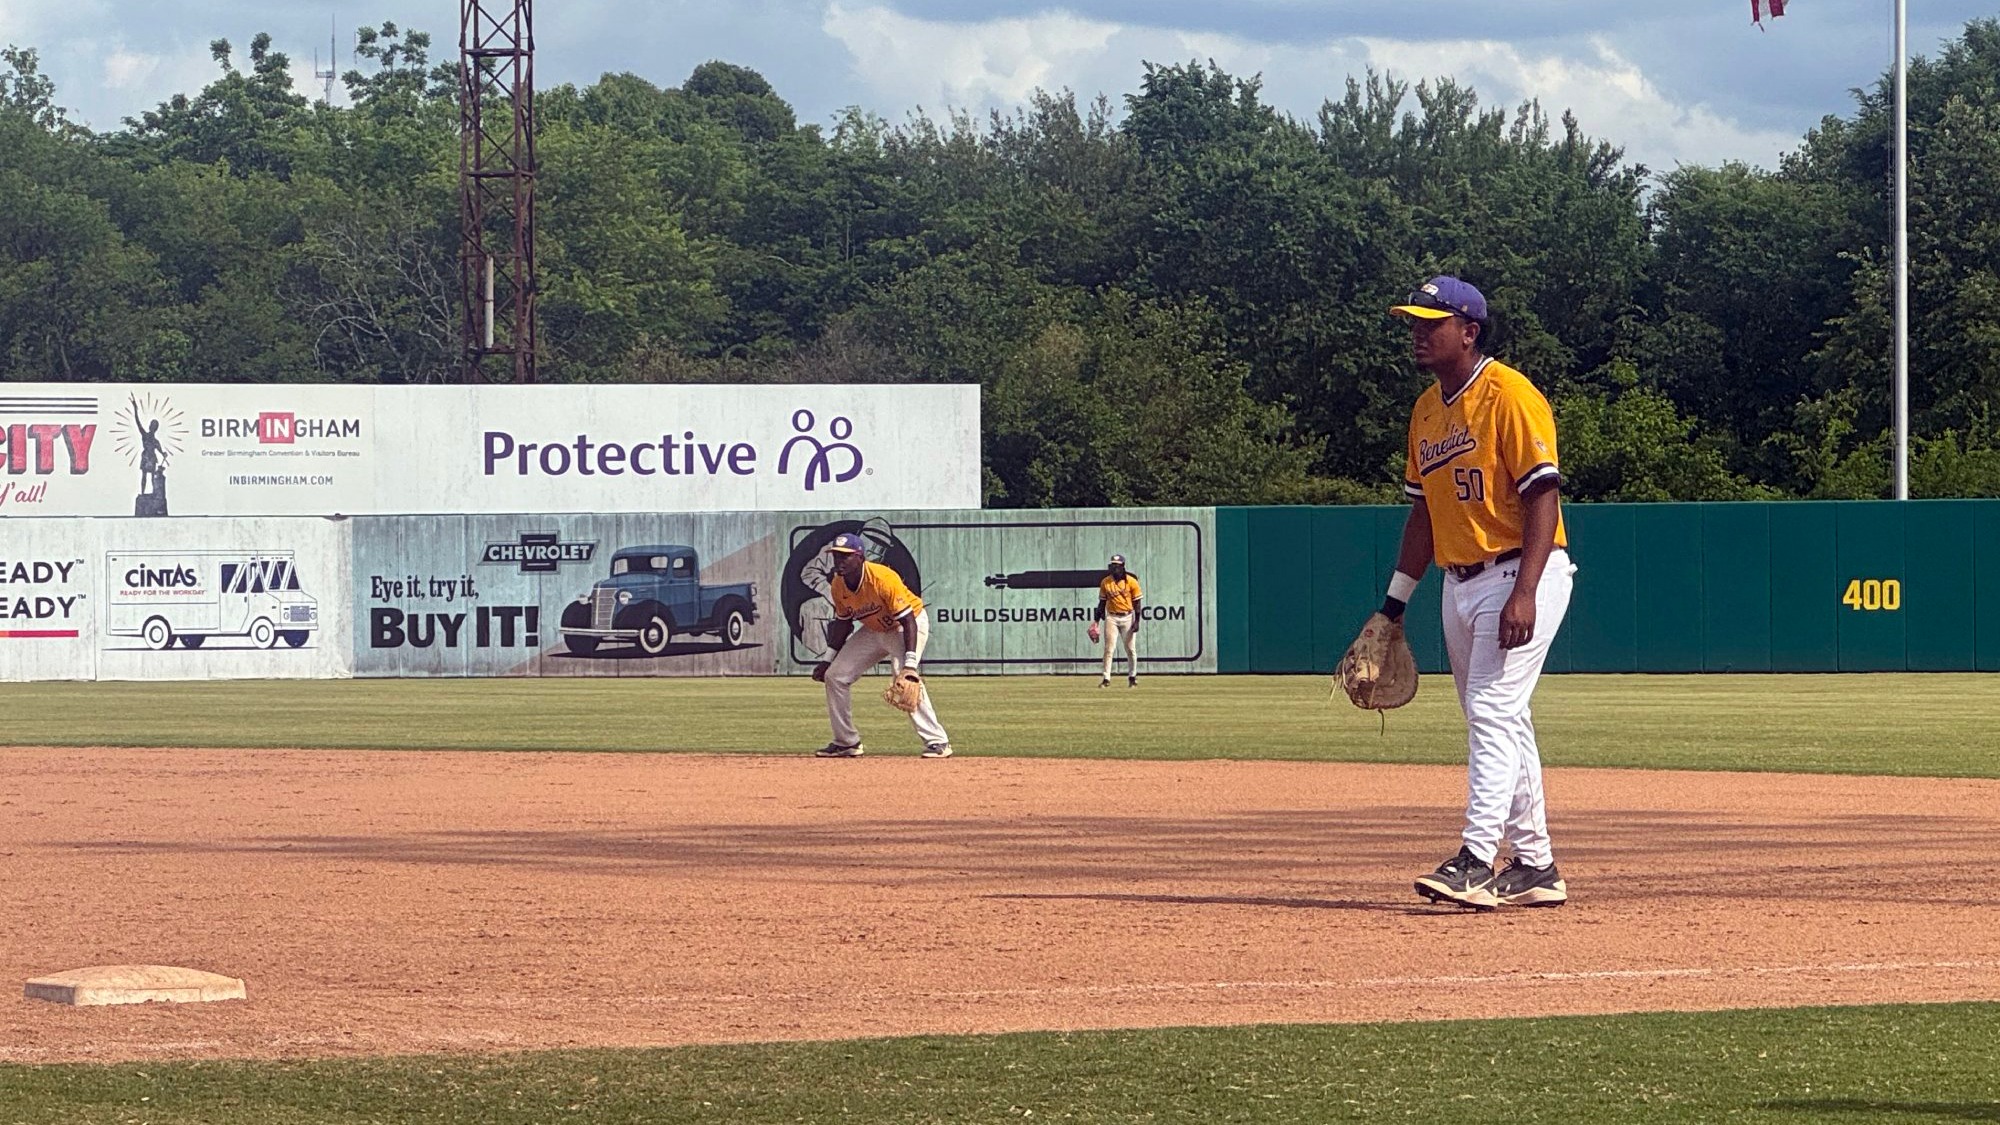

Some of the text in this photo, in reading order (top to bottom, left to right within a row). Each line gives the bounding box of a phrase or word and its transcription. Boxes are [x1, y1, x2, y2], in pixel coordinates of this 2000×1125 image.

[202, 419, 359, 438] BIRMINGHAM
[0, 424, 97, 475] ITY
[484, 431, 756, 476] Protective
[1419, 423, 1475, 468] Benedict
[230, 476, 333, 486] INBIRMINGHAM.COM
[1455, 468, 1485, 503] 50
[488, 545, 590, 560] CHEVROLET
[371, 575, 479, 602] Eye it, try it,
[1842, 579, 1901, 610] 400
[371, 605, 539, 648] BUY IT!
